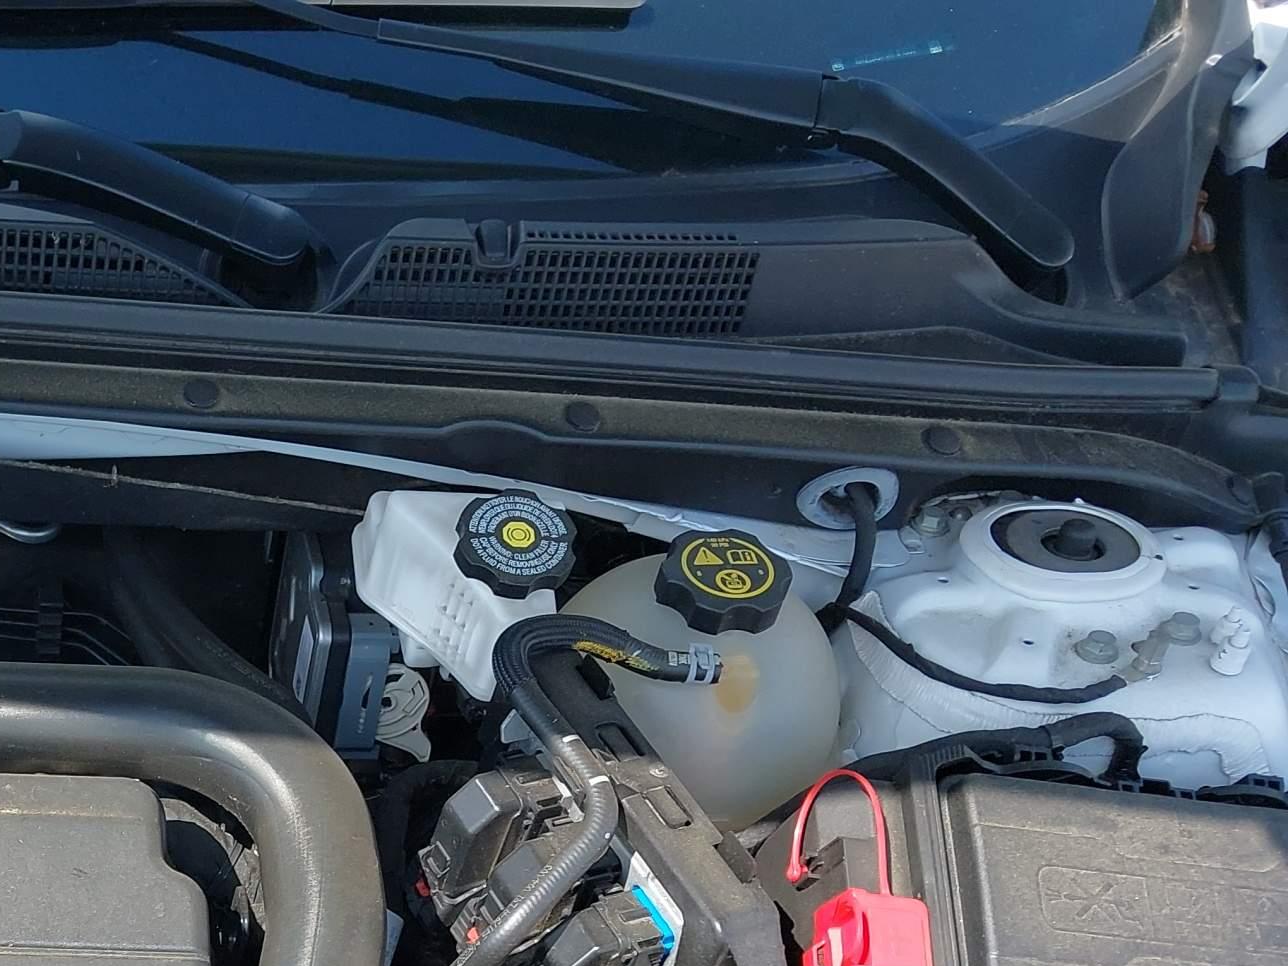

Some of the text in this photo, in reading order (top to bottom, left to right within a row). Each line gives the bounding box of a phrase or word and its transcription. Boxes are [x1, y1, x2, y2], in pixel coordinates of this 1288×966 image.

[470, 537, 482, 550] DOT
[478, 551, 497, 566] FLUID
[495, 562, 515, 574] FROM
[521, 564, 547, 575] SEALED
[543, 541, 568, 569] CONTAINER
[479, 537, 490, 548] CAP
[485, 547, 509, 564] BEFORE
[538, 552, 552, 562] USE
[545, 540, 559, 555] ONLY
[513, 551, 536, 560] CLEAN
[532, 539, 549, 556] FILLER
